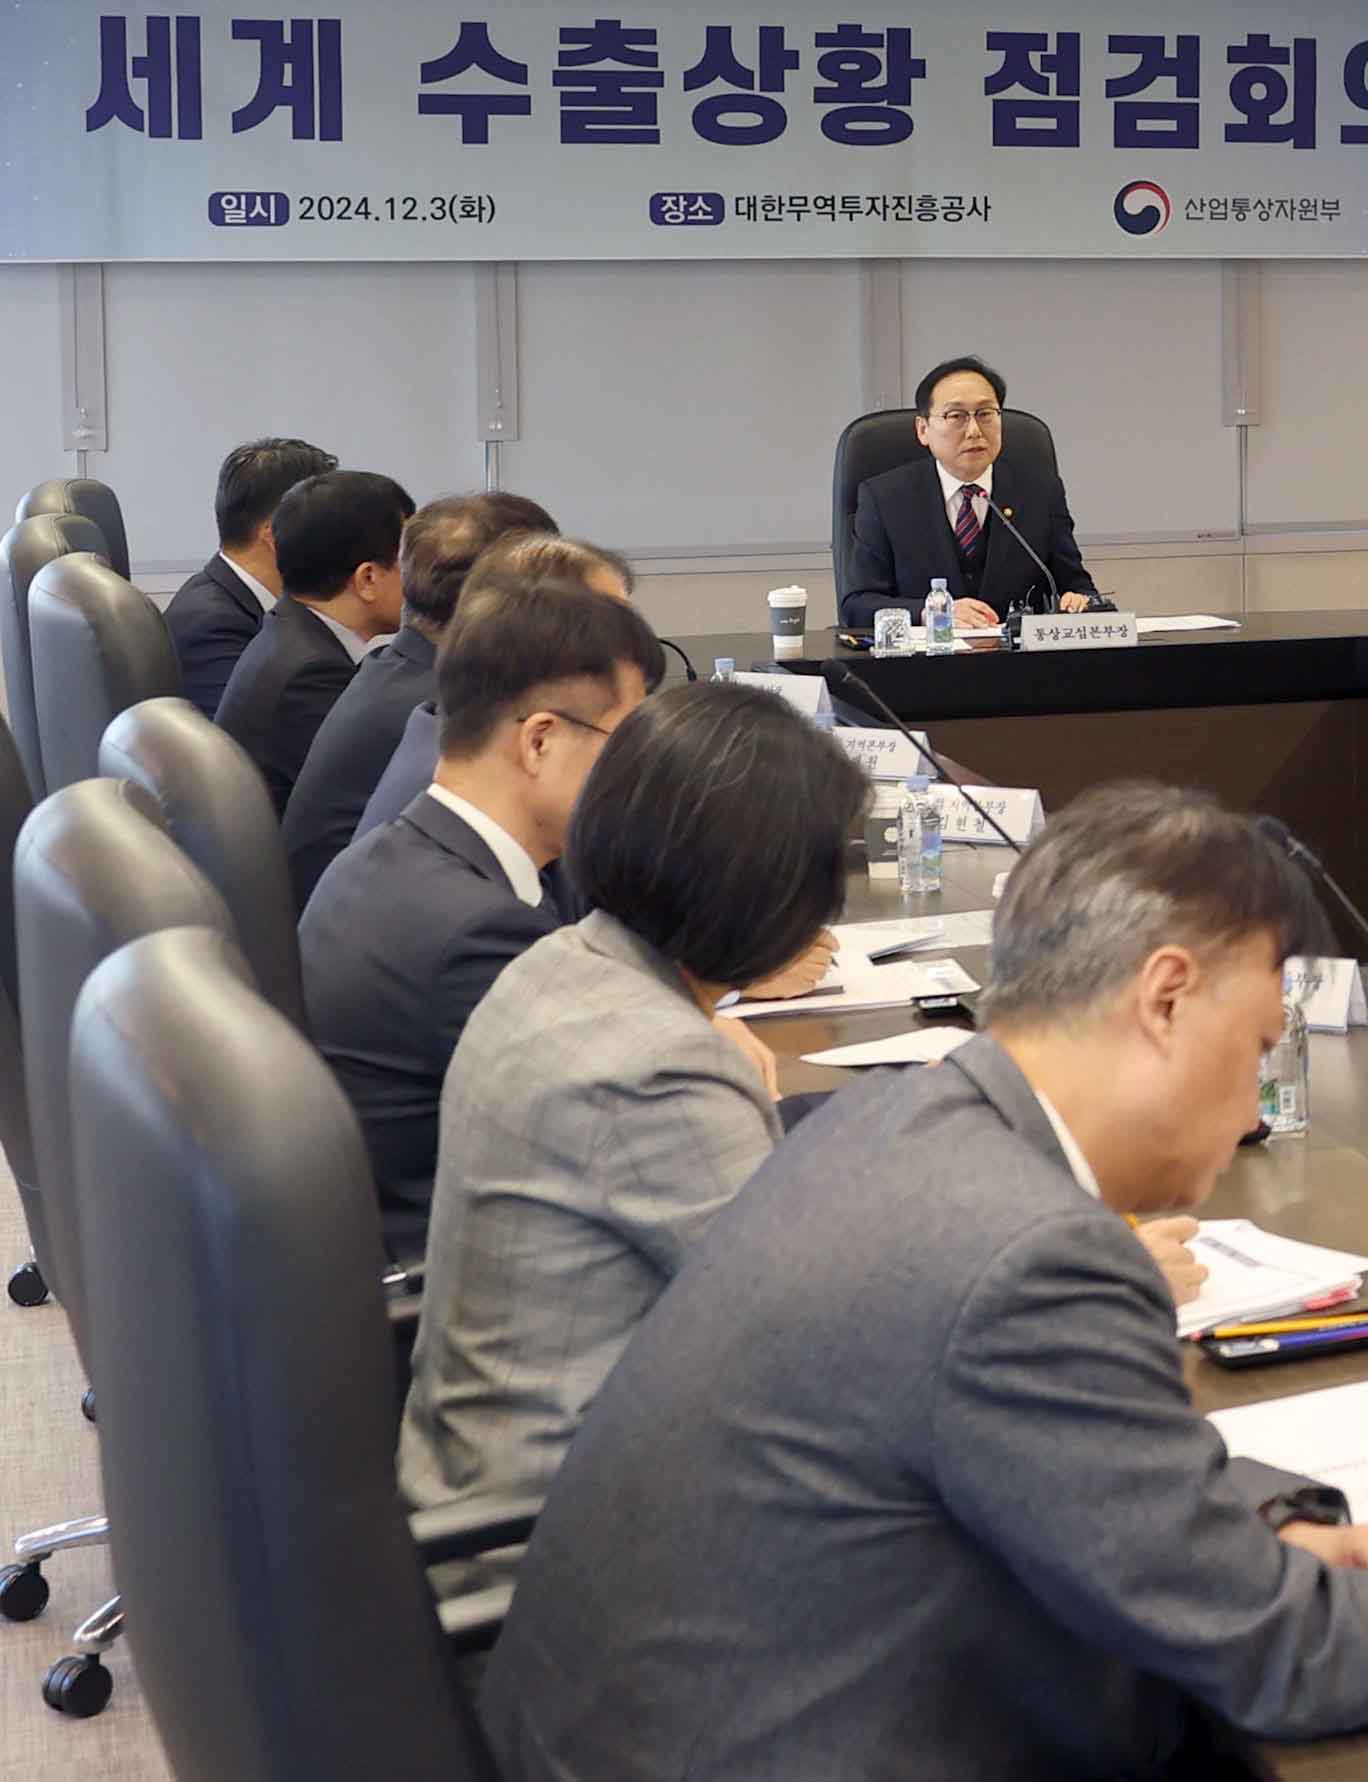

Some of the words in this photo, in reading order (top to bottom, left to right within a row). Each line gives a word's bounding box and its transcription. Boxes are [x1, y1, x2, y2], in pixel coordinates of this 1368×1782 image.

[86, 15, 343, 142] 세계
[418, 19, 927, 147] 수출상황
[219, 193, 278, 226] 일시
[298, 195, 497, 227] 2024.12.3(화)
[659, 193, 717, 226] 장소
[733, 194, 992, 225] 대한무역투자진흥공사
[1184, 196, 1342, 224] 산업통상자원부
